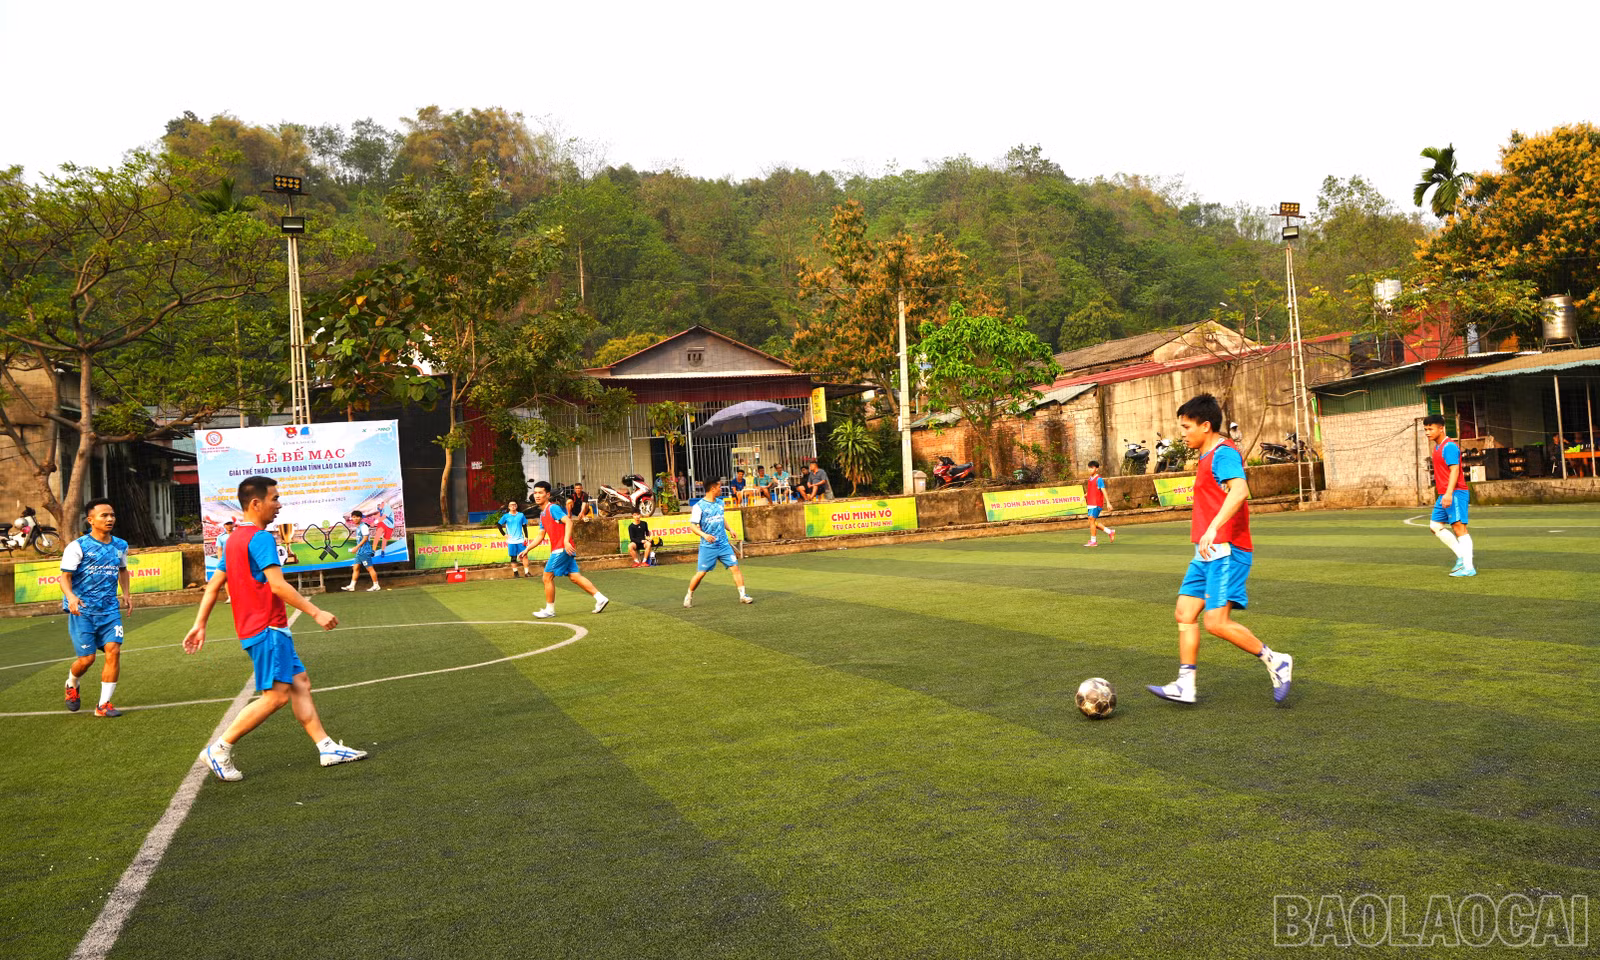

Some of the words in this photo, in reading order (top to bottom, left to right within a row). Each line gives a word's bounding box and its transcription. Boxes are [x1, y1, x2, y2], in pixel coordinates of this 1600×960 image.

[256, 448, 278, 464] LỄ
[282, 446, 304, 462] BẾ
[308, 448, 345, 461] MẠC
[852, 511, 876, 520] MINH
[442, 545, 455, 553] AN
[138, 568, 161, 577] ANH
